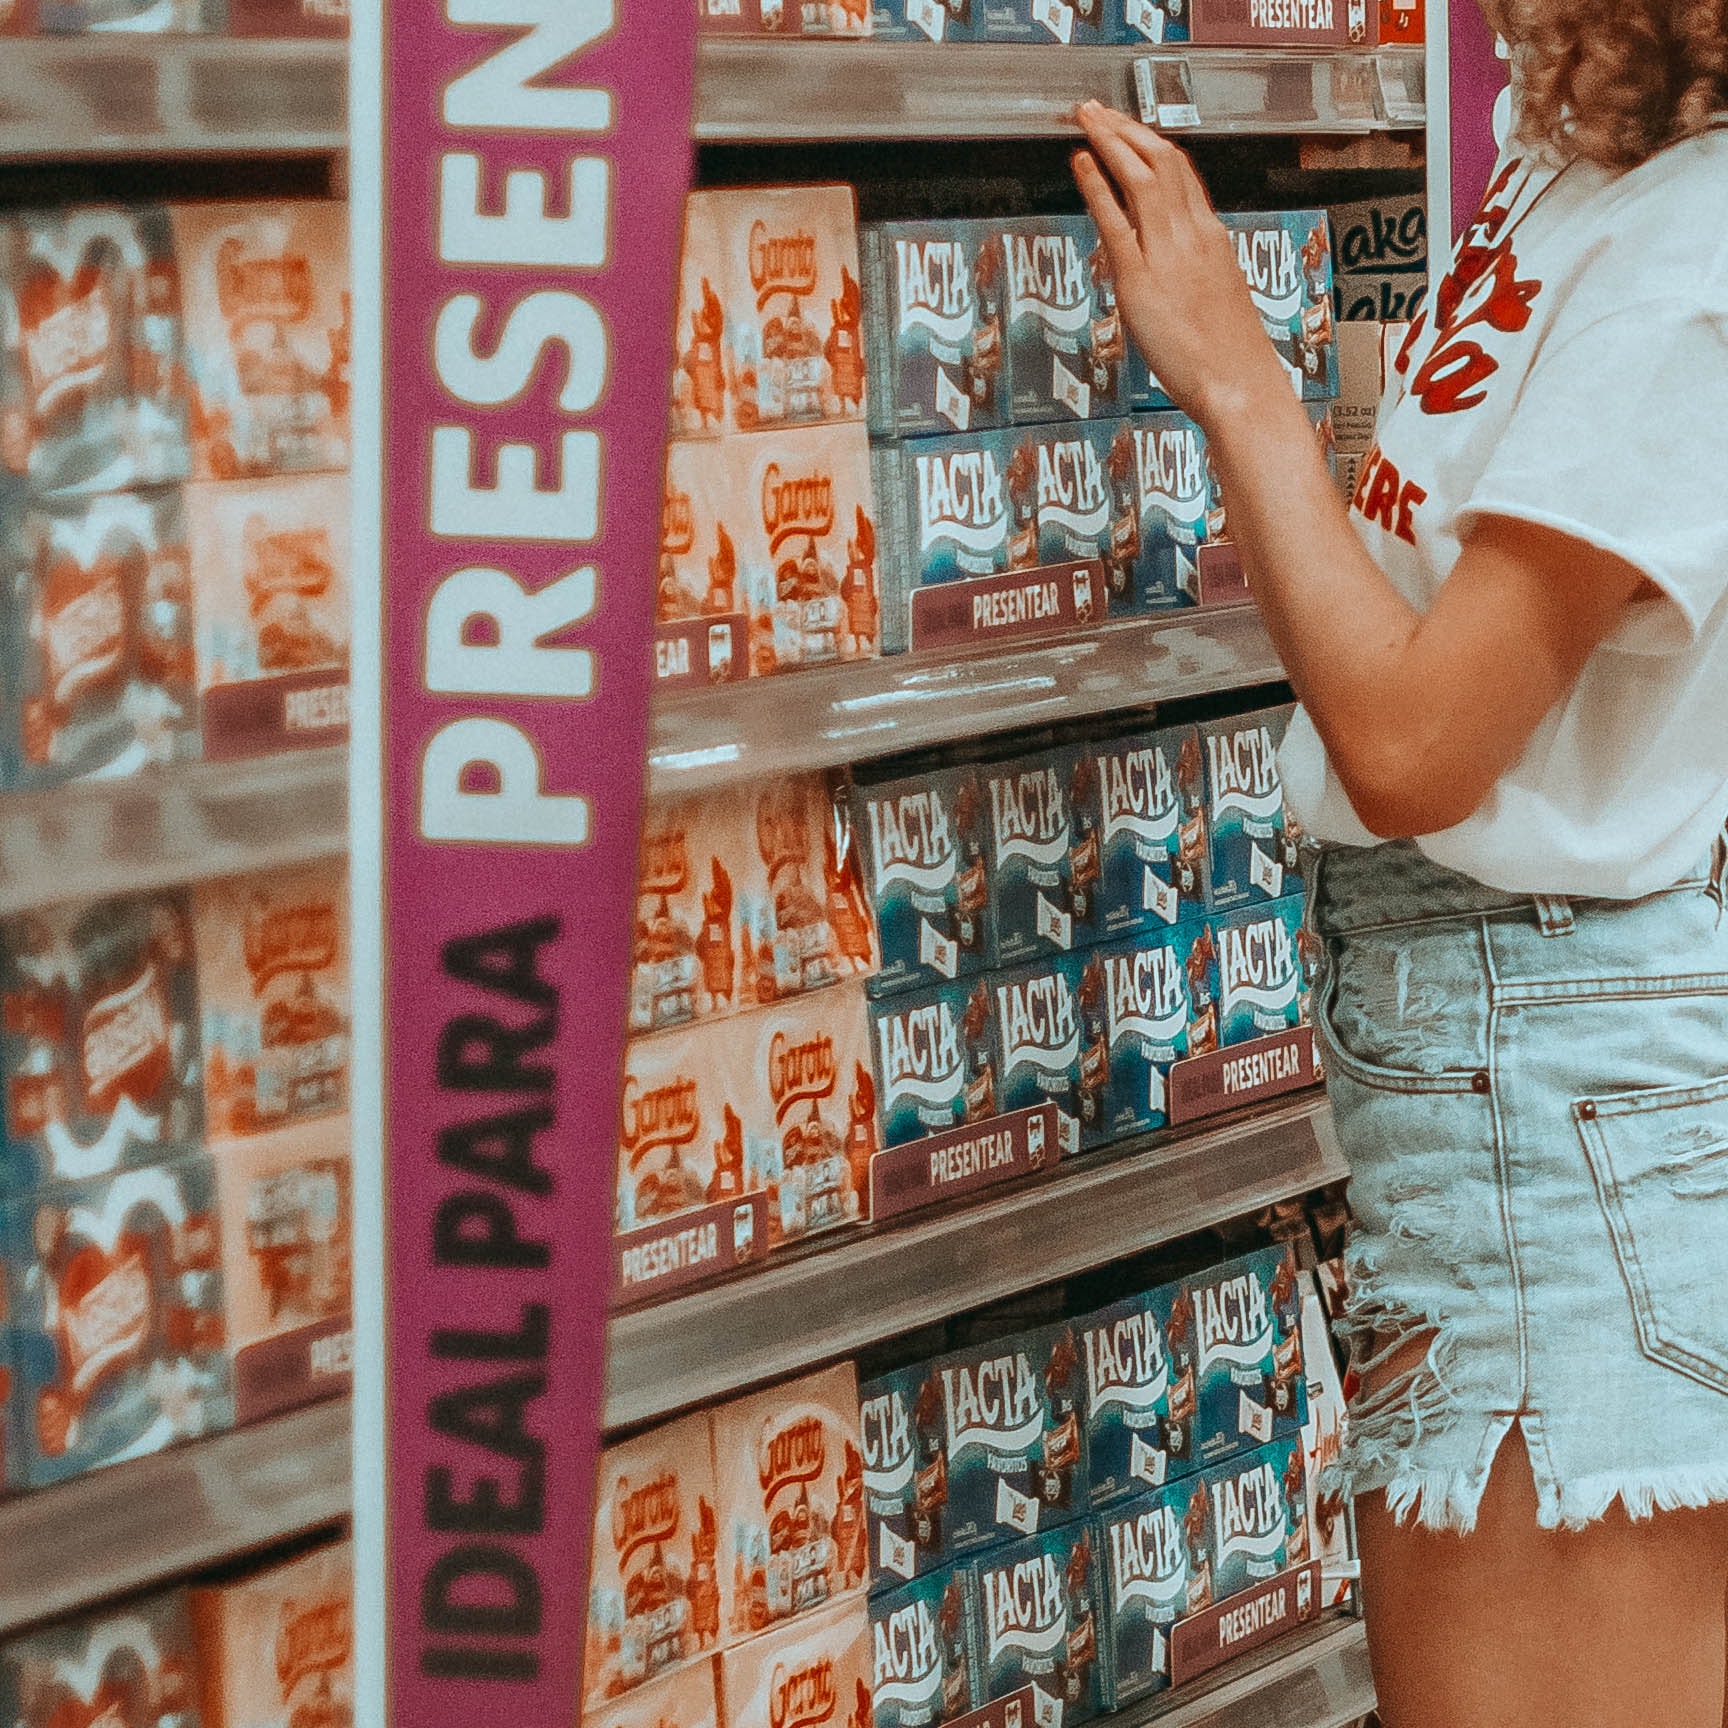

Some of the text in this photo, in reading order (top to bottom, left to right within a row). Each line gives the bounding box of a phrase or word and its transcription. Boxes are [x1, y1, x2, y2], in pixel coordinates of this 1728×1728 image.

[896, 240, 970, 328] LACTA
[1002, 233, 1085, 321] LACTA
[1227, 229, 1297, 297] ACTA
[917, 450, 1006, 546] LACTA
[1038, 439, 1105, 513] ACTA
[1134, 428, 1203, 512] LACTA
[972, 581, 1060, 631] PRESENTEAR
[989, 767, 1067, 866] LACTA
[1098, 745, 1177, 842] LACTA
[1206, 725, 1281, 820] LACTA
[867, 790, 953, 892] LACTA
[1104, 945, 1185, 1046] LACTA
[1217, 917, 1297, 1015] LACTA
[878, 1002, 962, 1107] LACTA
[998, 972, 1077, 1073] LACTA
[1222, 1043, 1301, 1096] PRESENTEAR
[432, 914, 562, 1270] PARA
[929, 1130, 1014, 1187] PRESENTEAR
[621, 1223, 718, 1287] PRESENTEAR
[1083, 1309, 1165, 1416] LACTA
[1192, 1271, 1271, 1372] LACTA
[858, 1390, 912, 1459] CTA
[941, 1352, 1041, 1458] LACTA
[418, 1284, 546, 1682] IDEAL
[1211, 1461, 1285, 1566] LACTA
[1110, 1504, 1186, 1611] LACTA
[874, 1599, 938, 1688] ACTA
[983, 1553, 1066, 1661] LACTA
[1218, 1587, 1287, 1649] PRESENTEAR
